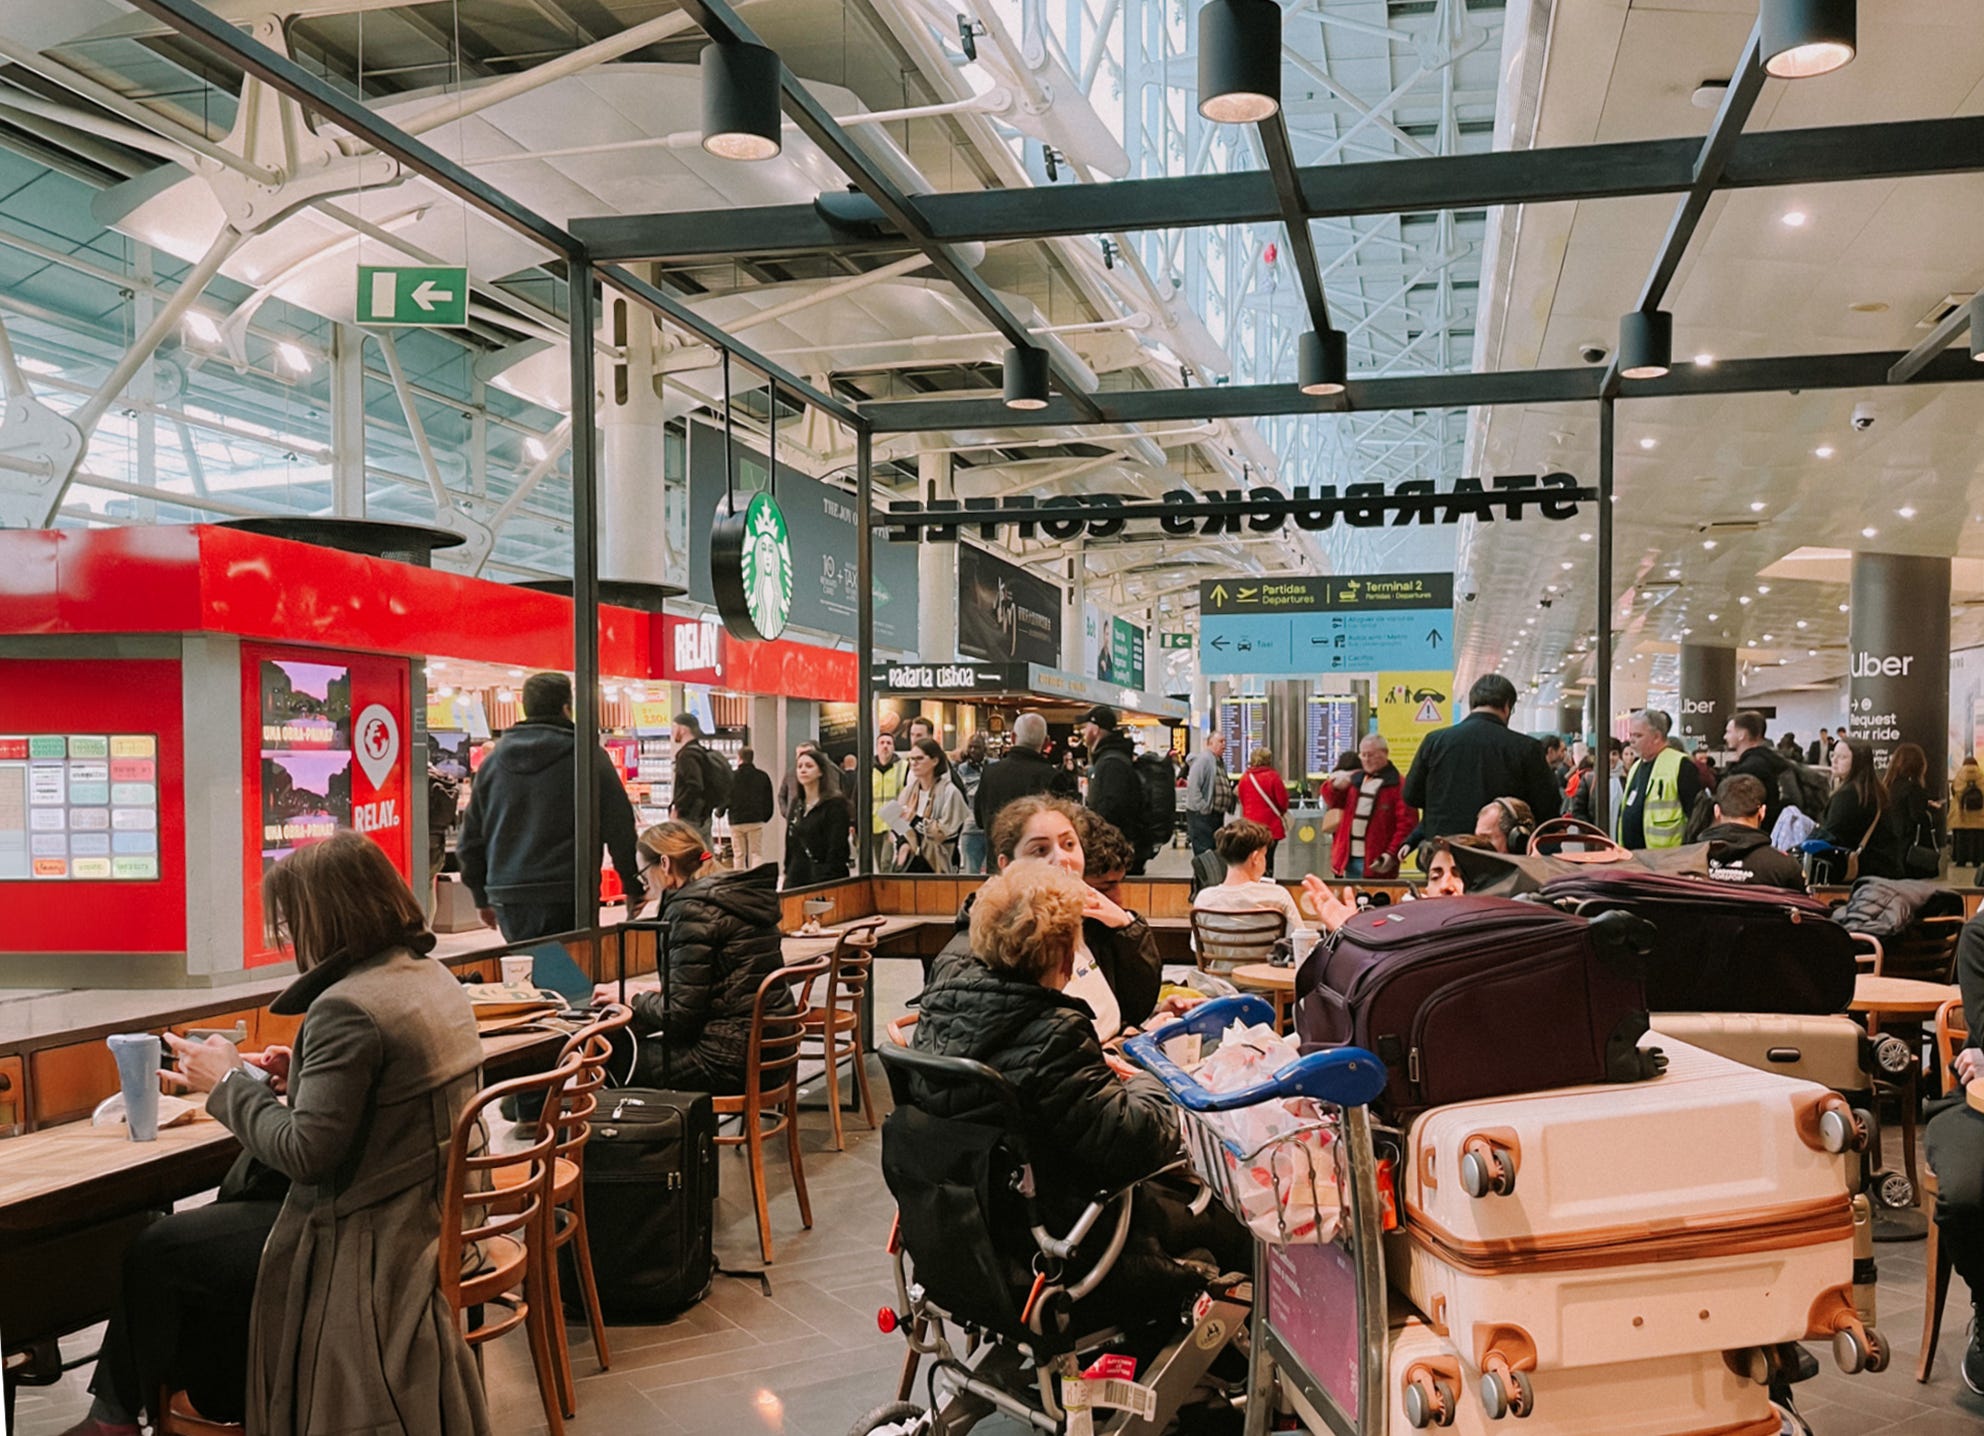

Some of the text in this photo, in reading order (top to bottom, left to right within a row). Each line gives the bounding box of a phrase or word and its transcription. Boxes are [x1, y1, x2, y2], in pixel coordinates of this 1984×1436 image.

[1262, 582, 1307, 594] Partidas
[1365, 579, 1423, 592] Terminal 2
[1262, 594, 1315, 605] Departures
[1851, 651, 1915, 678] Uber
